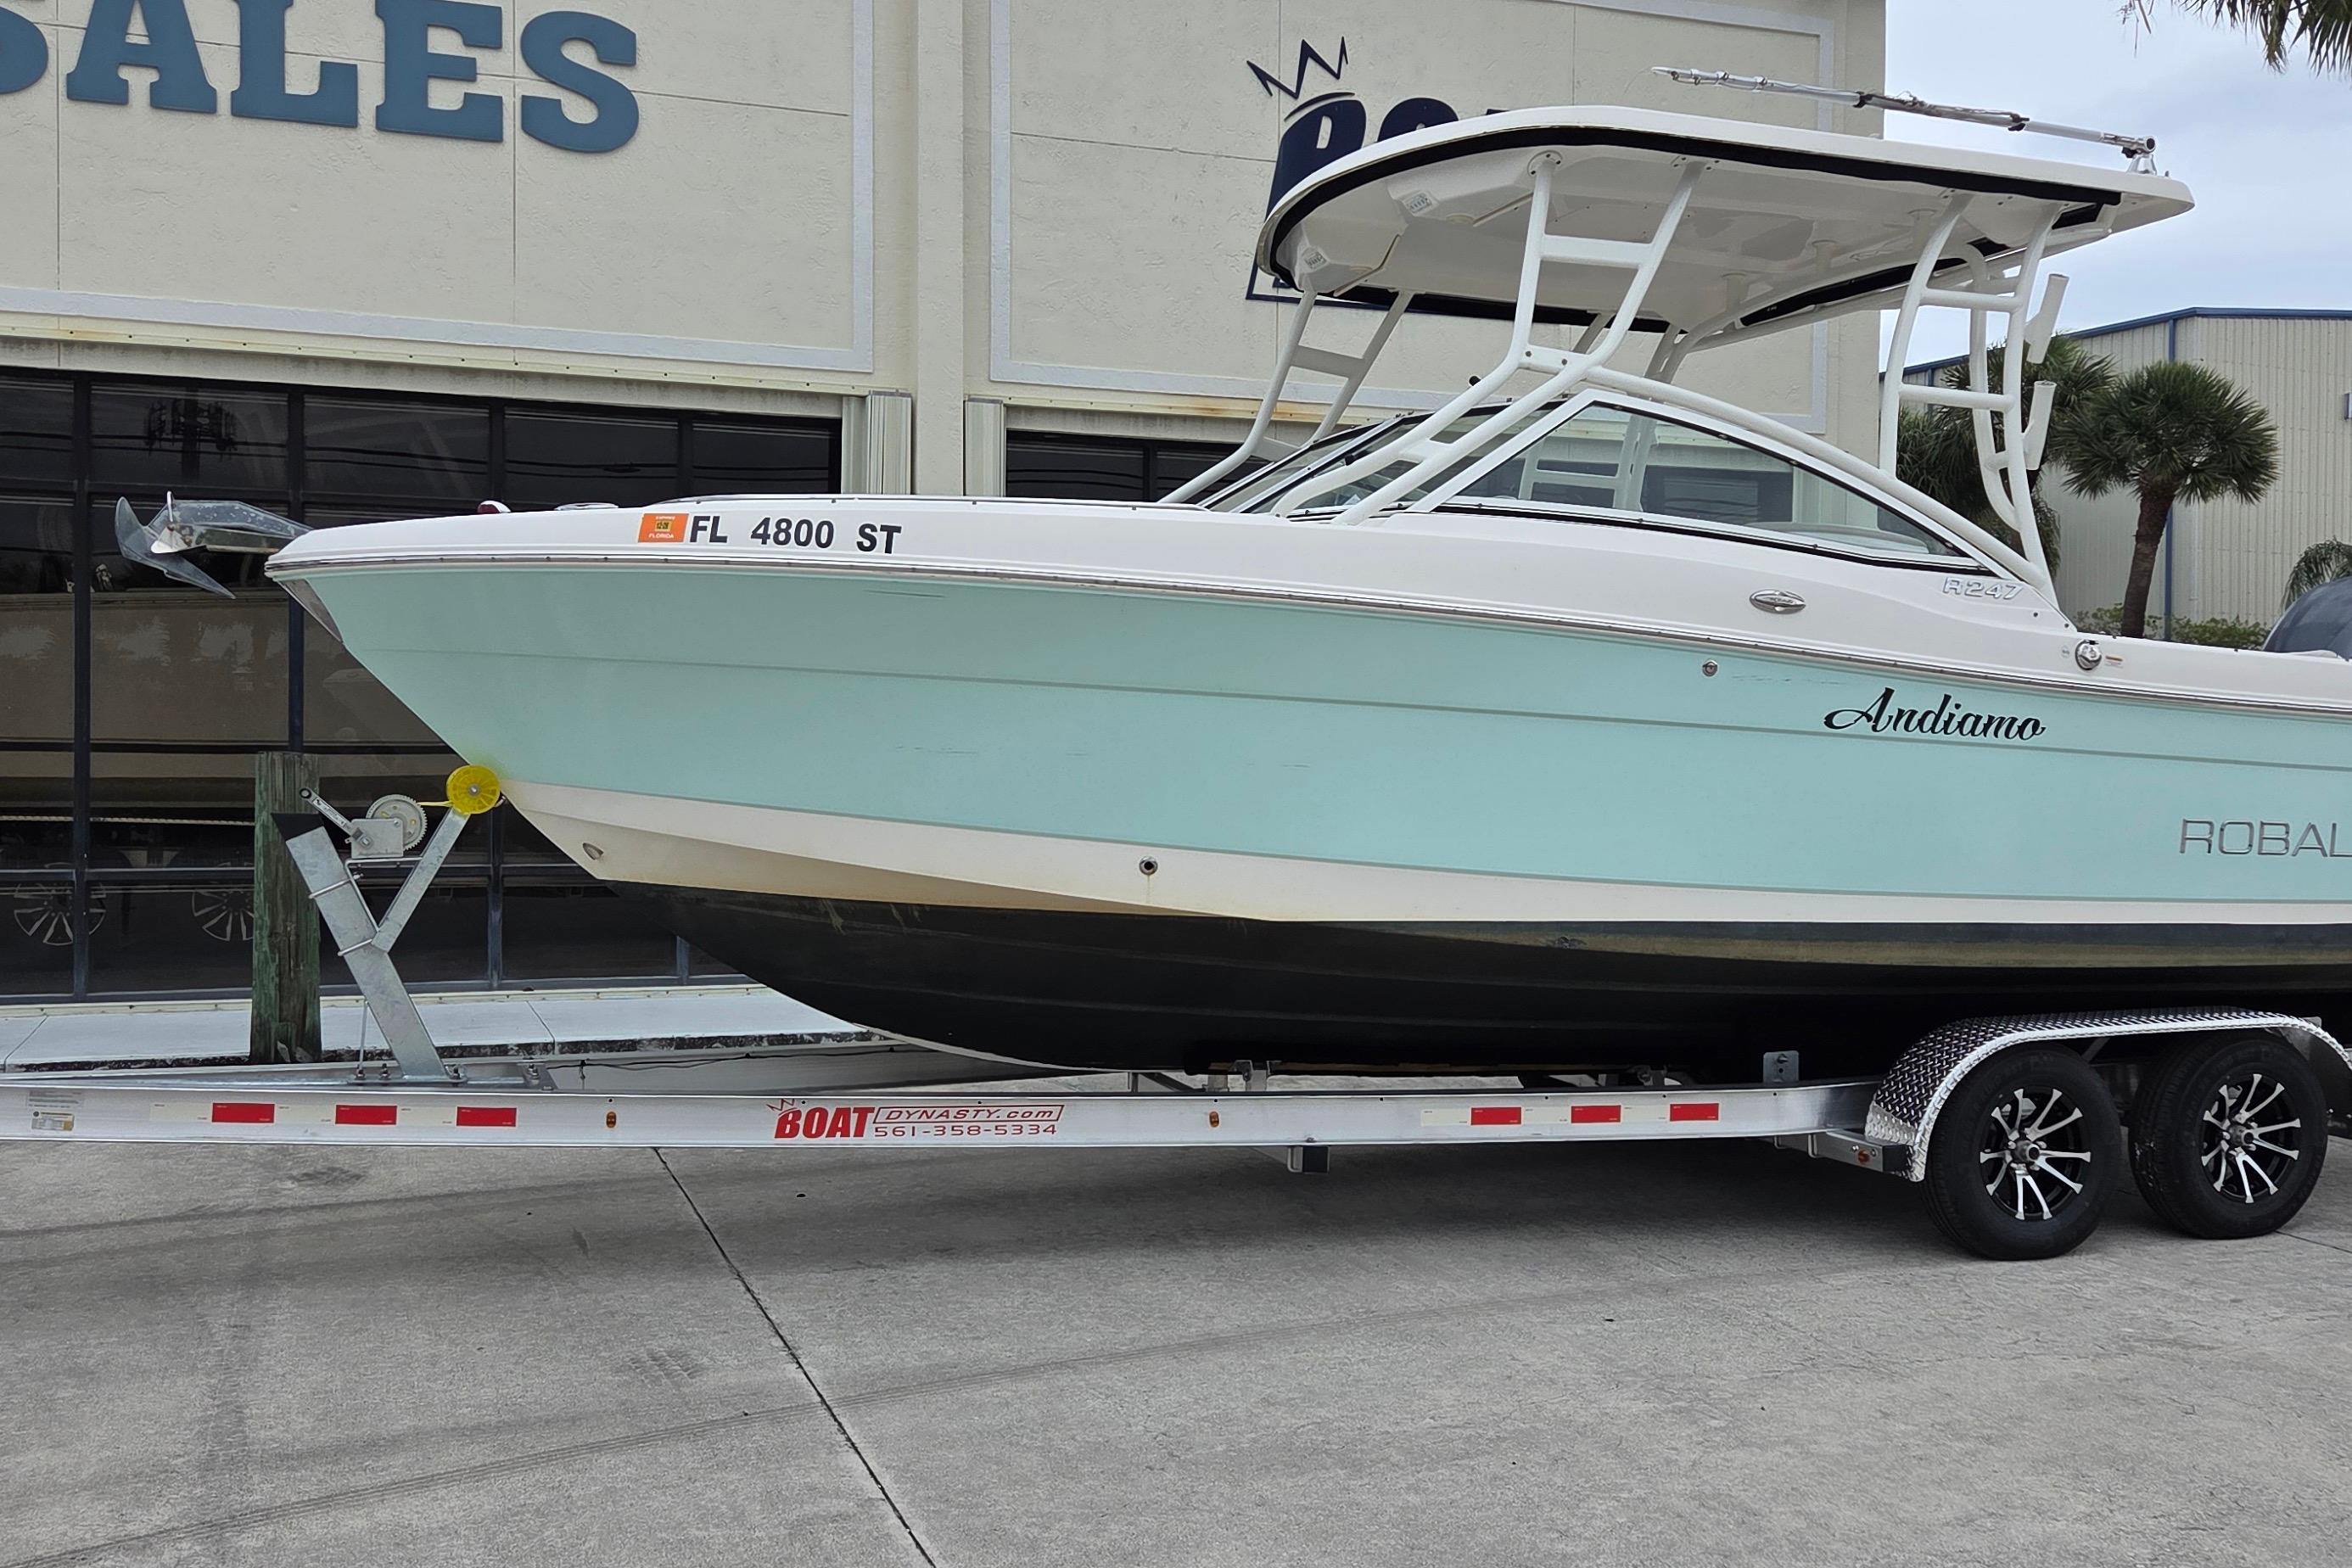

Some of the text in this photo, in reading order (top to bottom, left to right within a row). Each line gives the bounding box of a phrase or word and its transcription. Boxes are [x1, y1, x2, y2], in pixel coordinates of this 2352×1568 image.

[689, 515, 902, 554] FL 4800 ST
[1942, 576, 2024, 601] R247
[1823, 686, 2047, 741] Andiamo
[2179, 818, 2352, 858] ROBAL
[774, 1106, 1060, 1139] BOAT DYNASTY.com
[874, 1123, 1057, 1137] 561-358-5334
